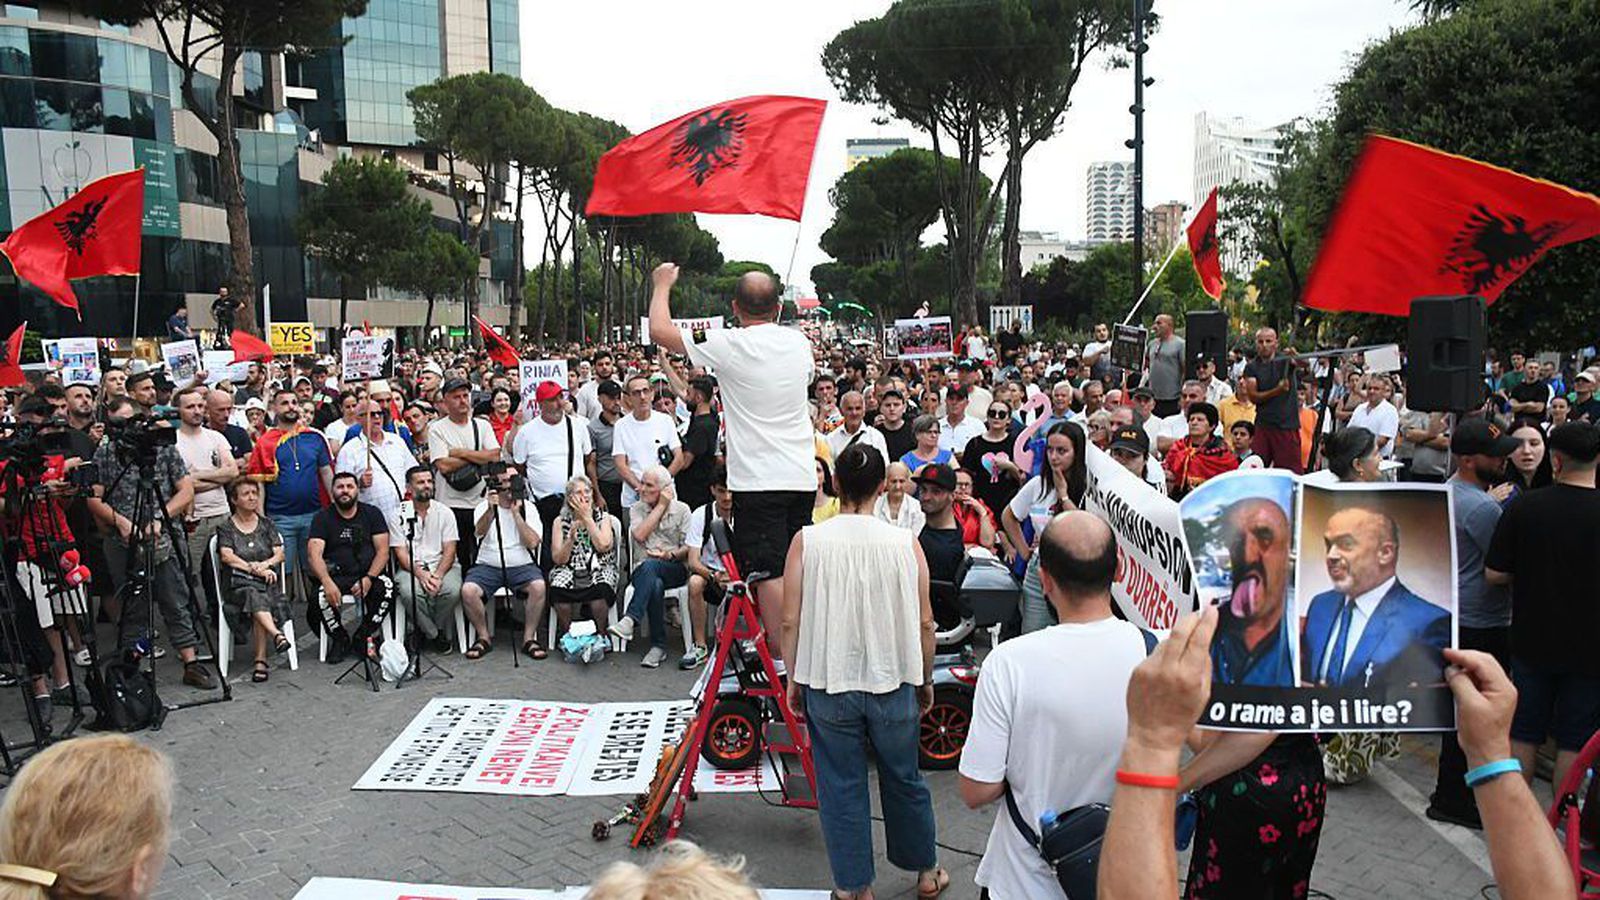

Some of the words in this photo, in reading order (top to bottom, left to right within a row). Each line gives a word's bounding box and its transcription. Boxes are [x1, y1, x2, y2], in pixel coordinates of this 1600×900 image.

[279, 326, 312, 342] YES
[523, 364, 562, 378] RINIA
[1209, 701, 1226, 722] o
[1230, 702, 1286, 724] rame
[1290, 705, 1306, 724] a
[1310, 698, 1335, 730] je
[1339, 698, 1349, 724] i
[1354, 698, 1412, 724] lire?
